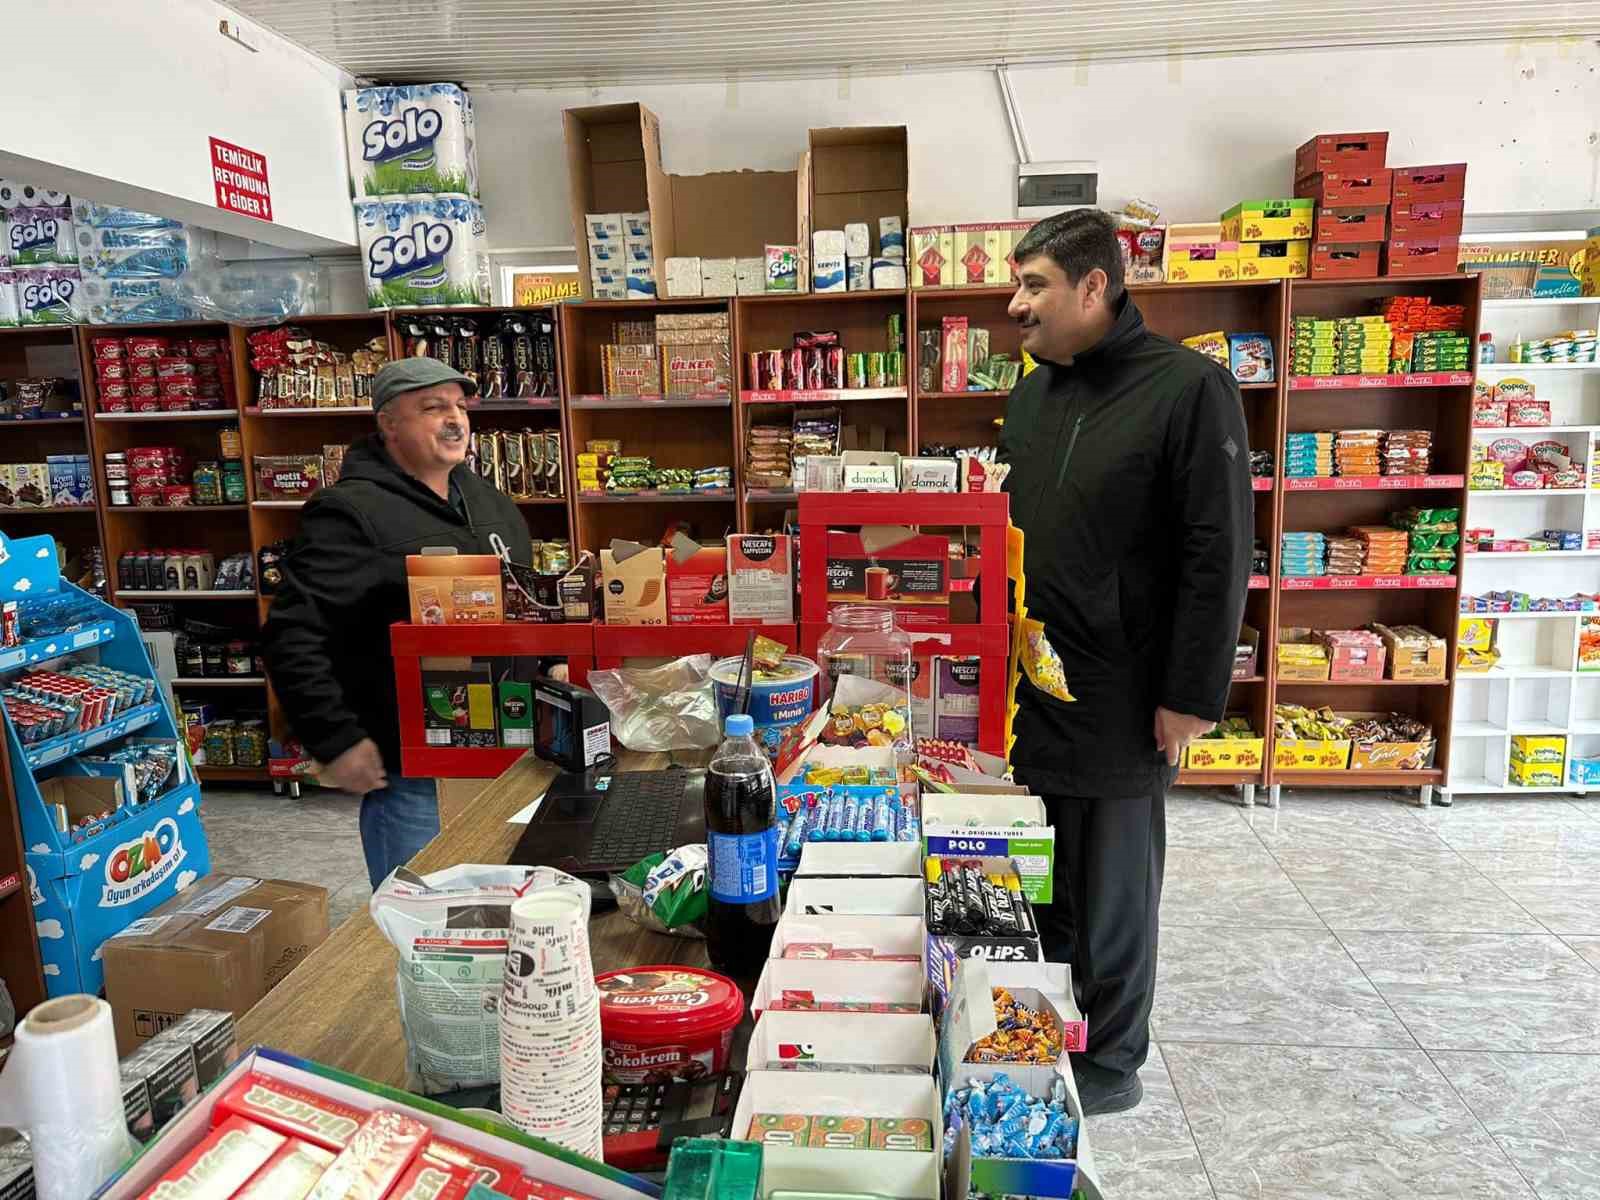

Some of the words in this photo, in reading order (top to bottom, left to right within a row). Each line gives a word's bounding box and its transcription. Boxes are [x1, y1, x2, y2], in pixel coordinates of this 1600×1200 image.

[364, 109, 442, 159] Solo
[215, 145, 263, 174] TEMİZLİK
[214, 166, 269, 197] REYONUNA
[230, 190, 260, 215] GİDER
[371, 223, 452, 278] Solo
[770, 687, 809, 706] HARIBO
[110, 822, 178, 883] OZMO
[948, 840, 986, 850] POLO
[107, 886, 131, 904] Oyun
